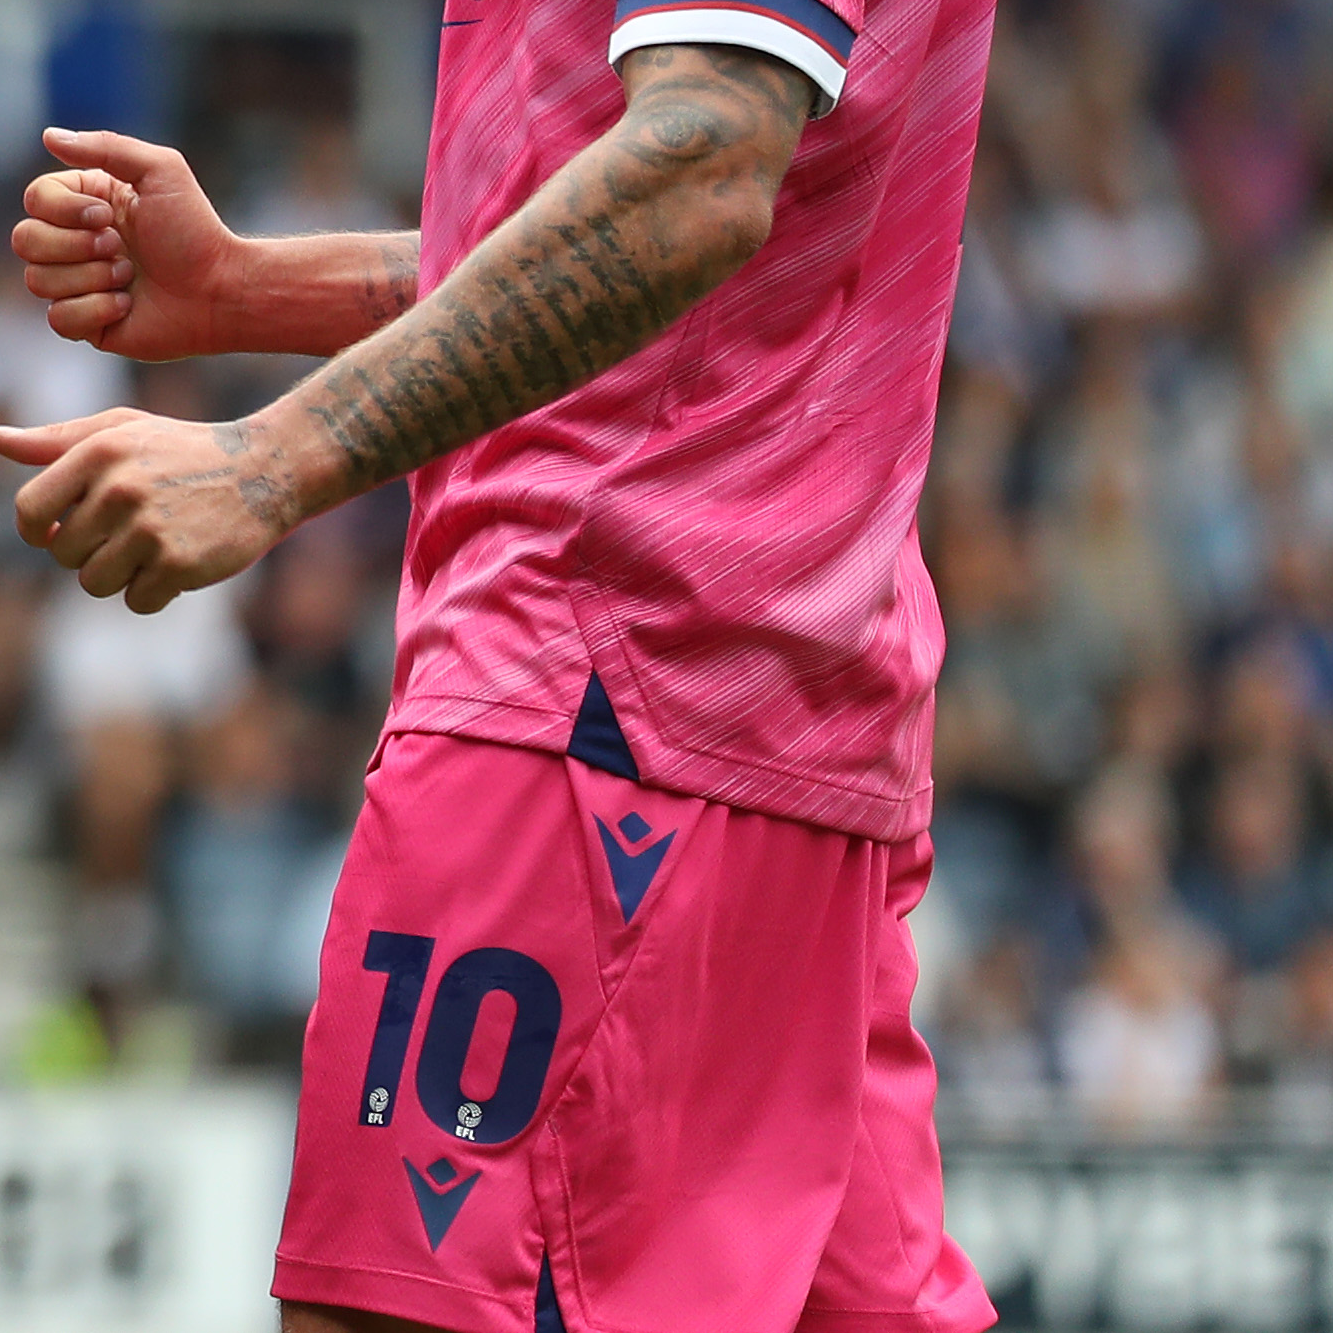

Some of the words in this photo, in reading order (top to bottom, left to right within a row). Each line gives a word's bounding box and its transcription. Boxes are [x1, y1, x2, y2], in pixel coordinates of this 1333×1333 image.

[358, 929, 563, 1145] 10
[367, 1112, 385, 1125] EFL
[455, 1124, 476, 1141] EFL
